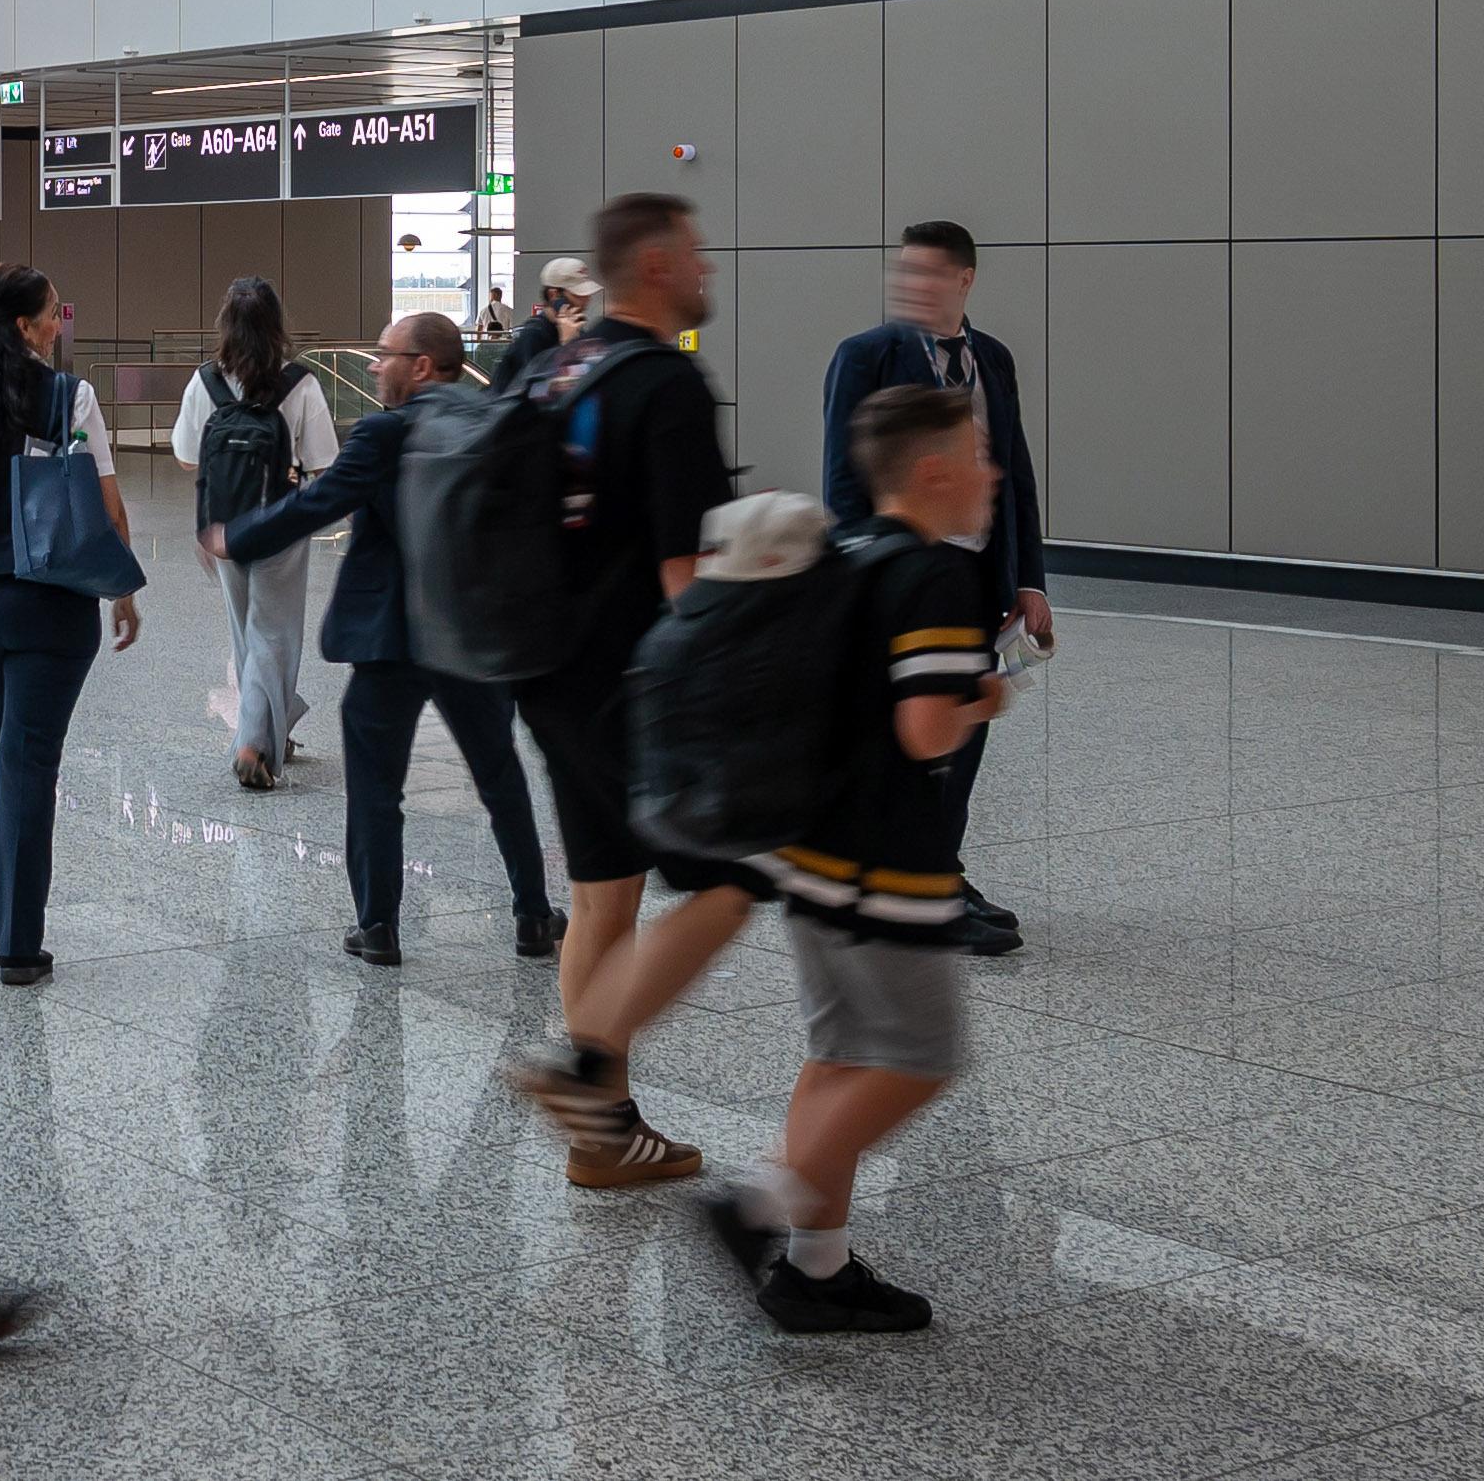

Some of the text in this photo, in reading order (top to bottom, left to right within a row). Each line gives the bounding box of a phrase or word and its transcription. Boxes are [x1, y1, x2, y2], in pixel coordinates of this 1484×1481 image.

[171, 125, 276, 155] Gate A60-A64
[319, 113, 435, 146] Gate A40-A51
